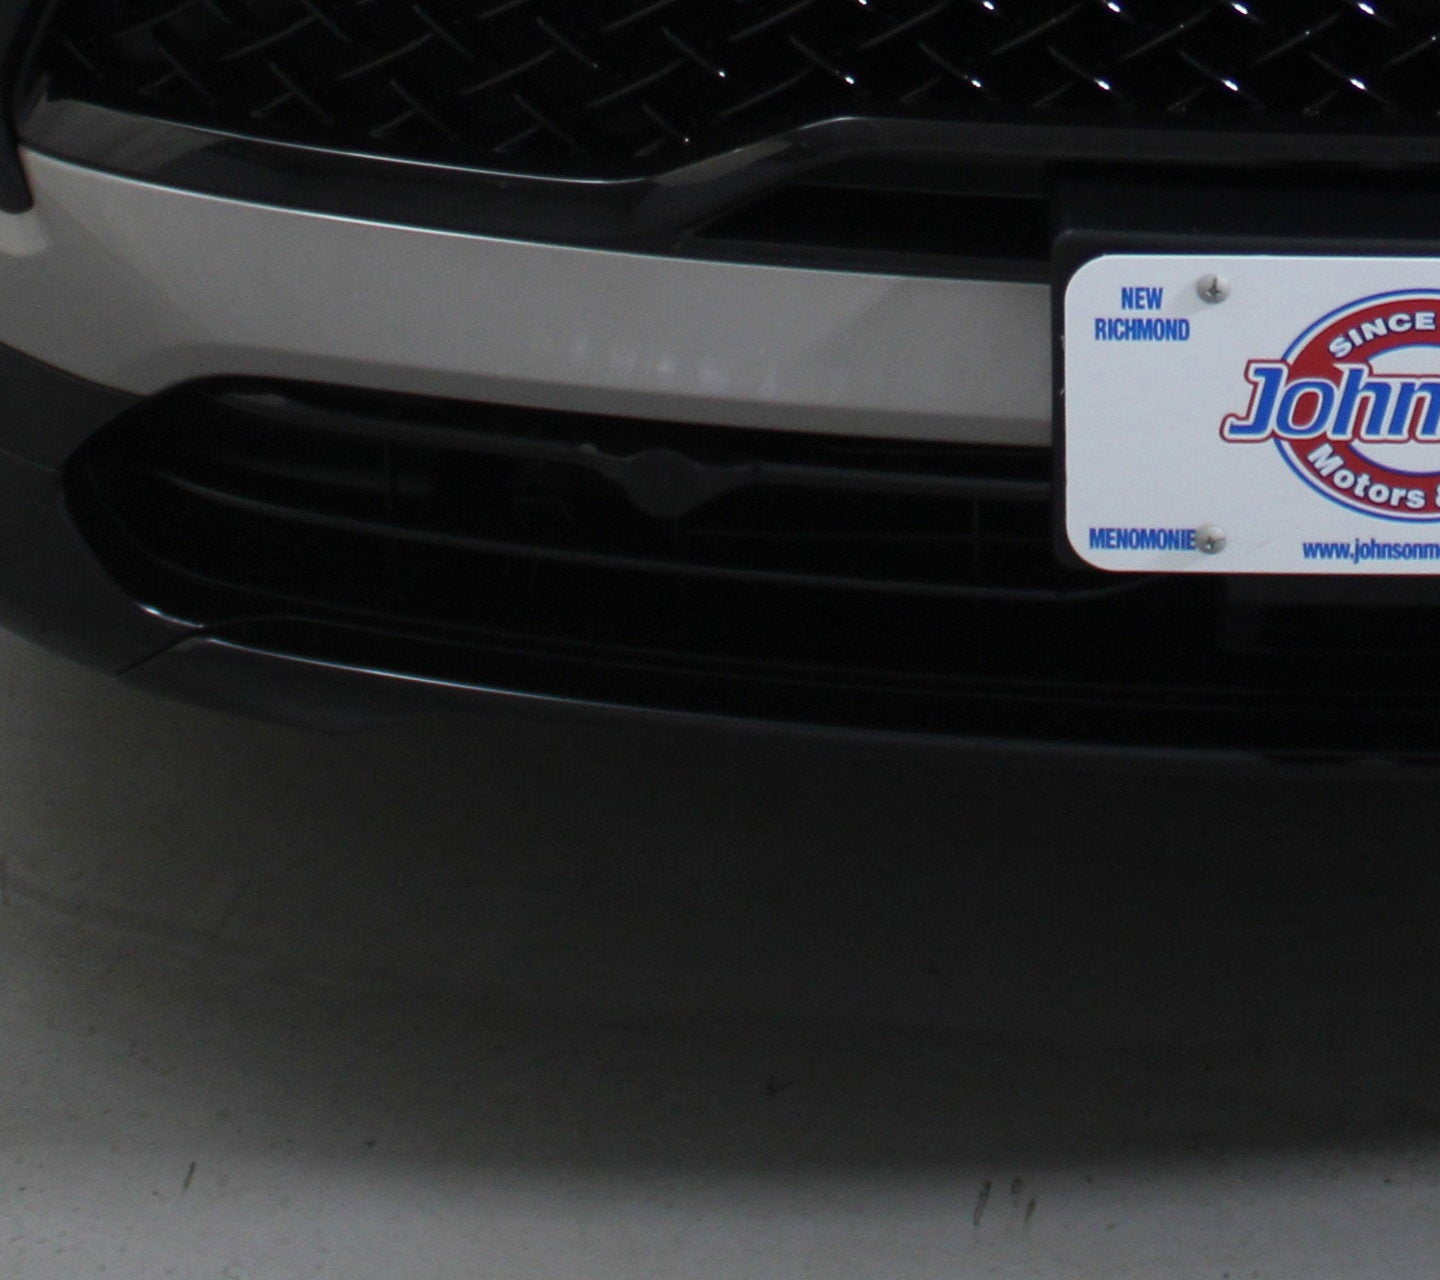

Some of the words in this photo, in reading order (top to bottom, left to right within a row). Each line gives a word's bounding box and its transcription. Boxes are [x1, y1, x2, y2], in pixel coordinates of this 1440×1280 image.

[1120, 287, 1163, 310] NEW
[1094, 317, 1191, 341] RICHMOND
[1329, 312, 1436, 358] SINCE
[1307, 444, 1426, 509] Motors
[1089, 528, 1197, 550] MENOMONIE
